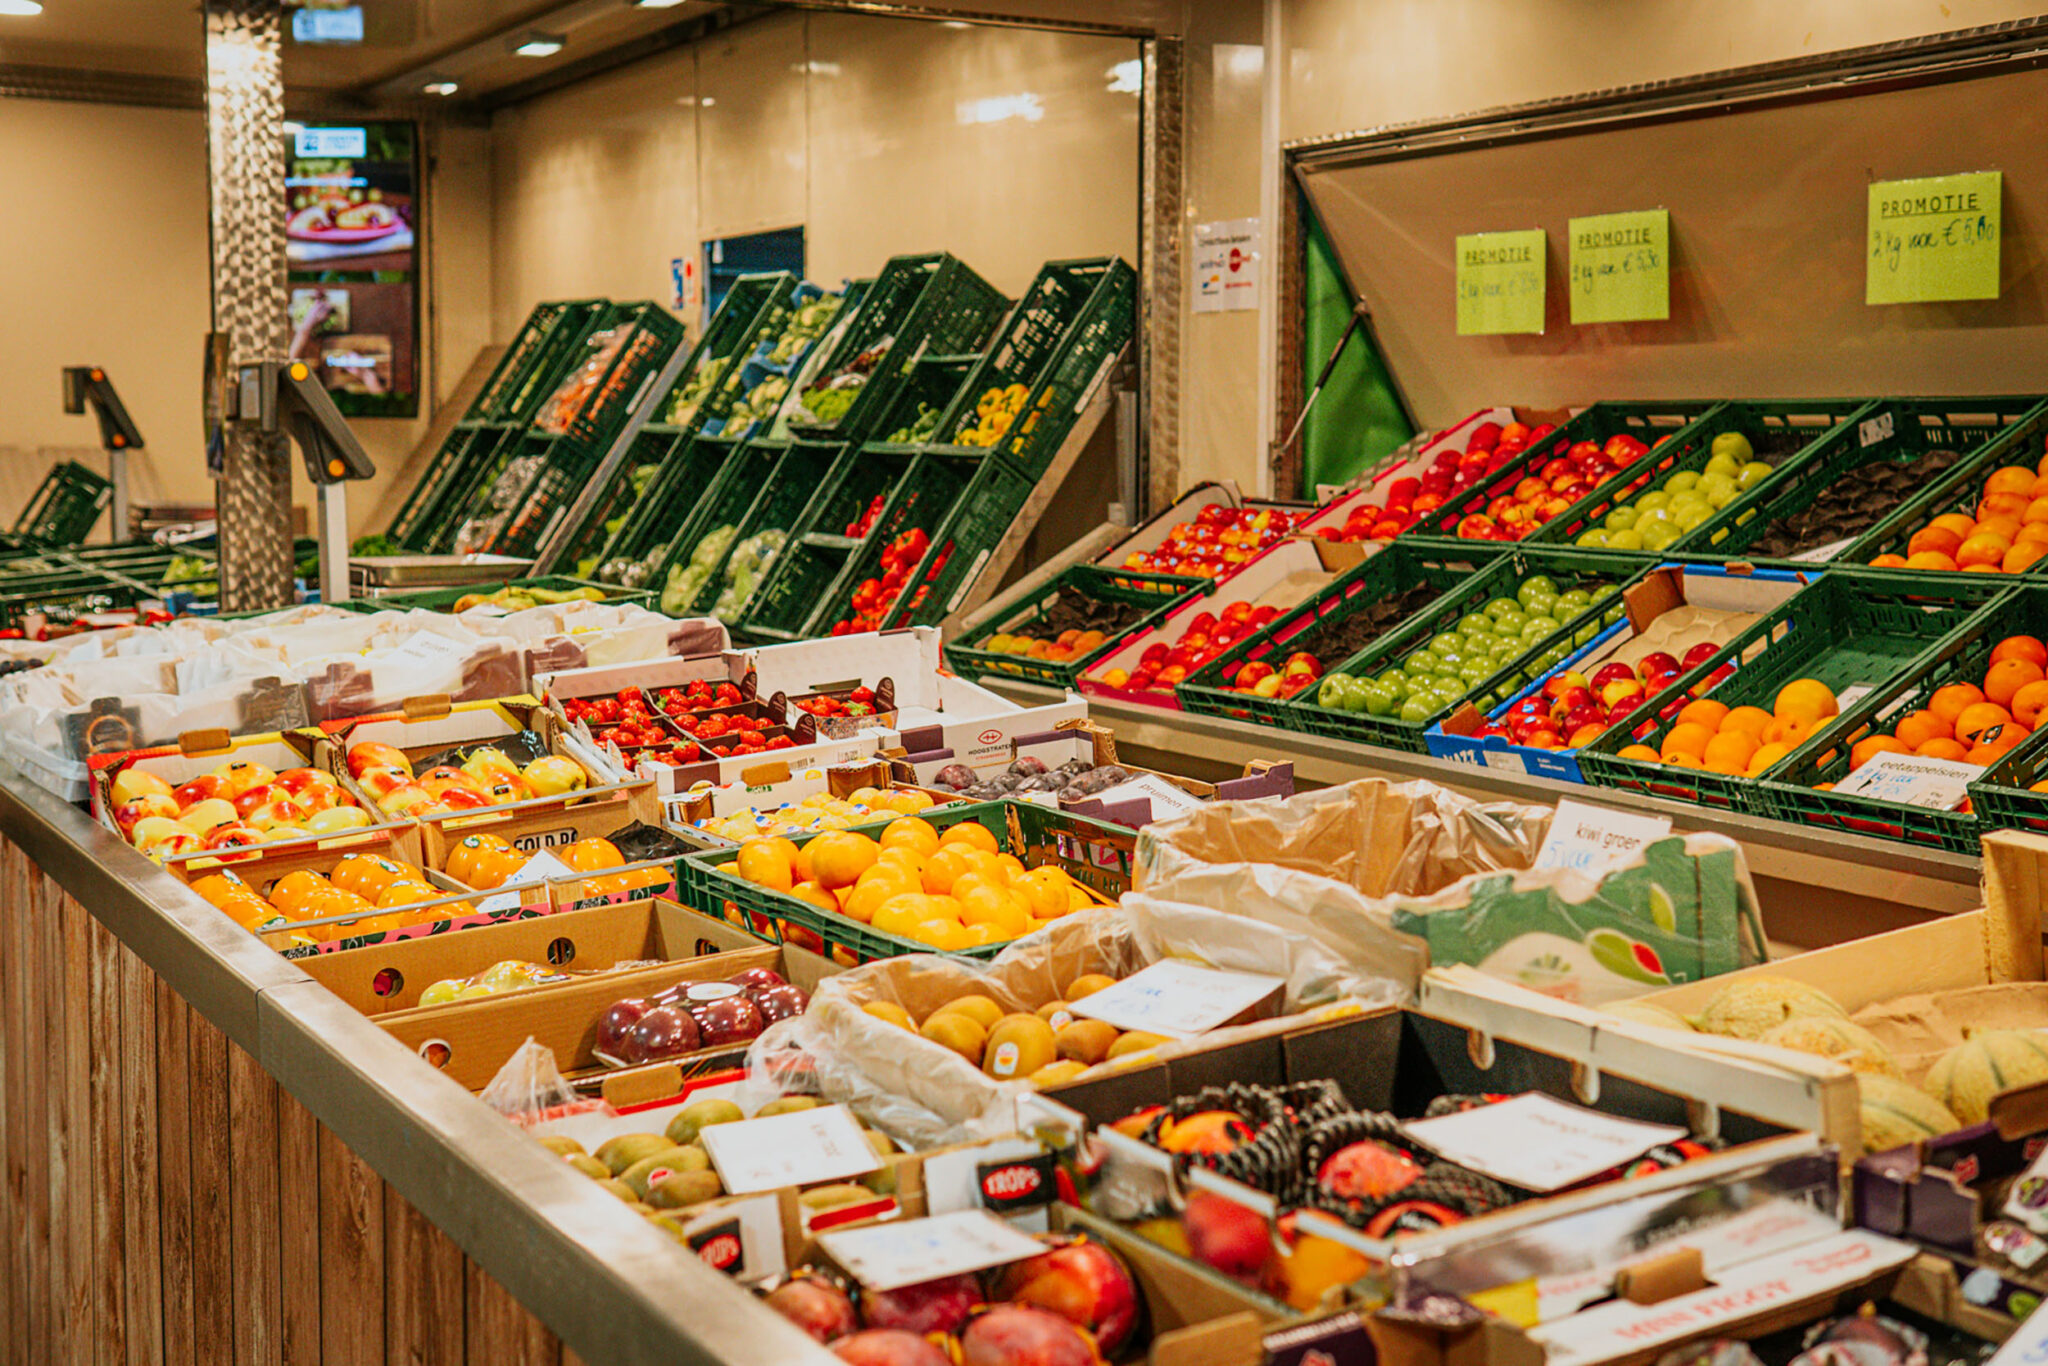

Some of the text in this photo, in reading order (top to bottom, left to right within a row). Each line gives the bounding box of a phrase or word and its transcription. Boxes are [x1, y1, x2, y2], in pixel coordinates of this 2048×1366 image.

[1880, 192, 1980, 217] PROMOTIE
[1578, 227, 1652, 249] PROMOTIE
[1464, 246, 1532, 265] PROMOTIE
[1138, 783, 1183, 809] pruimen
[1576, 821, 1604, 843] kiwi
